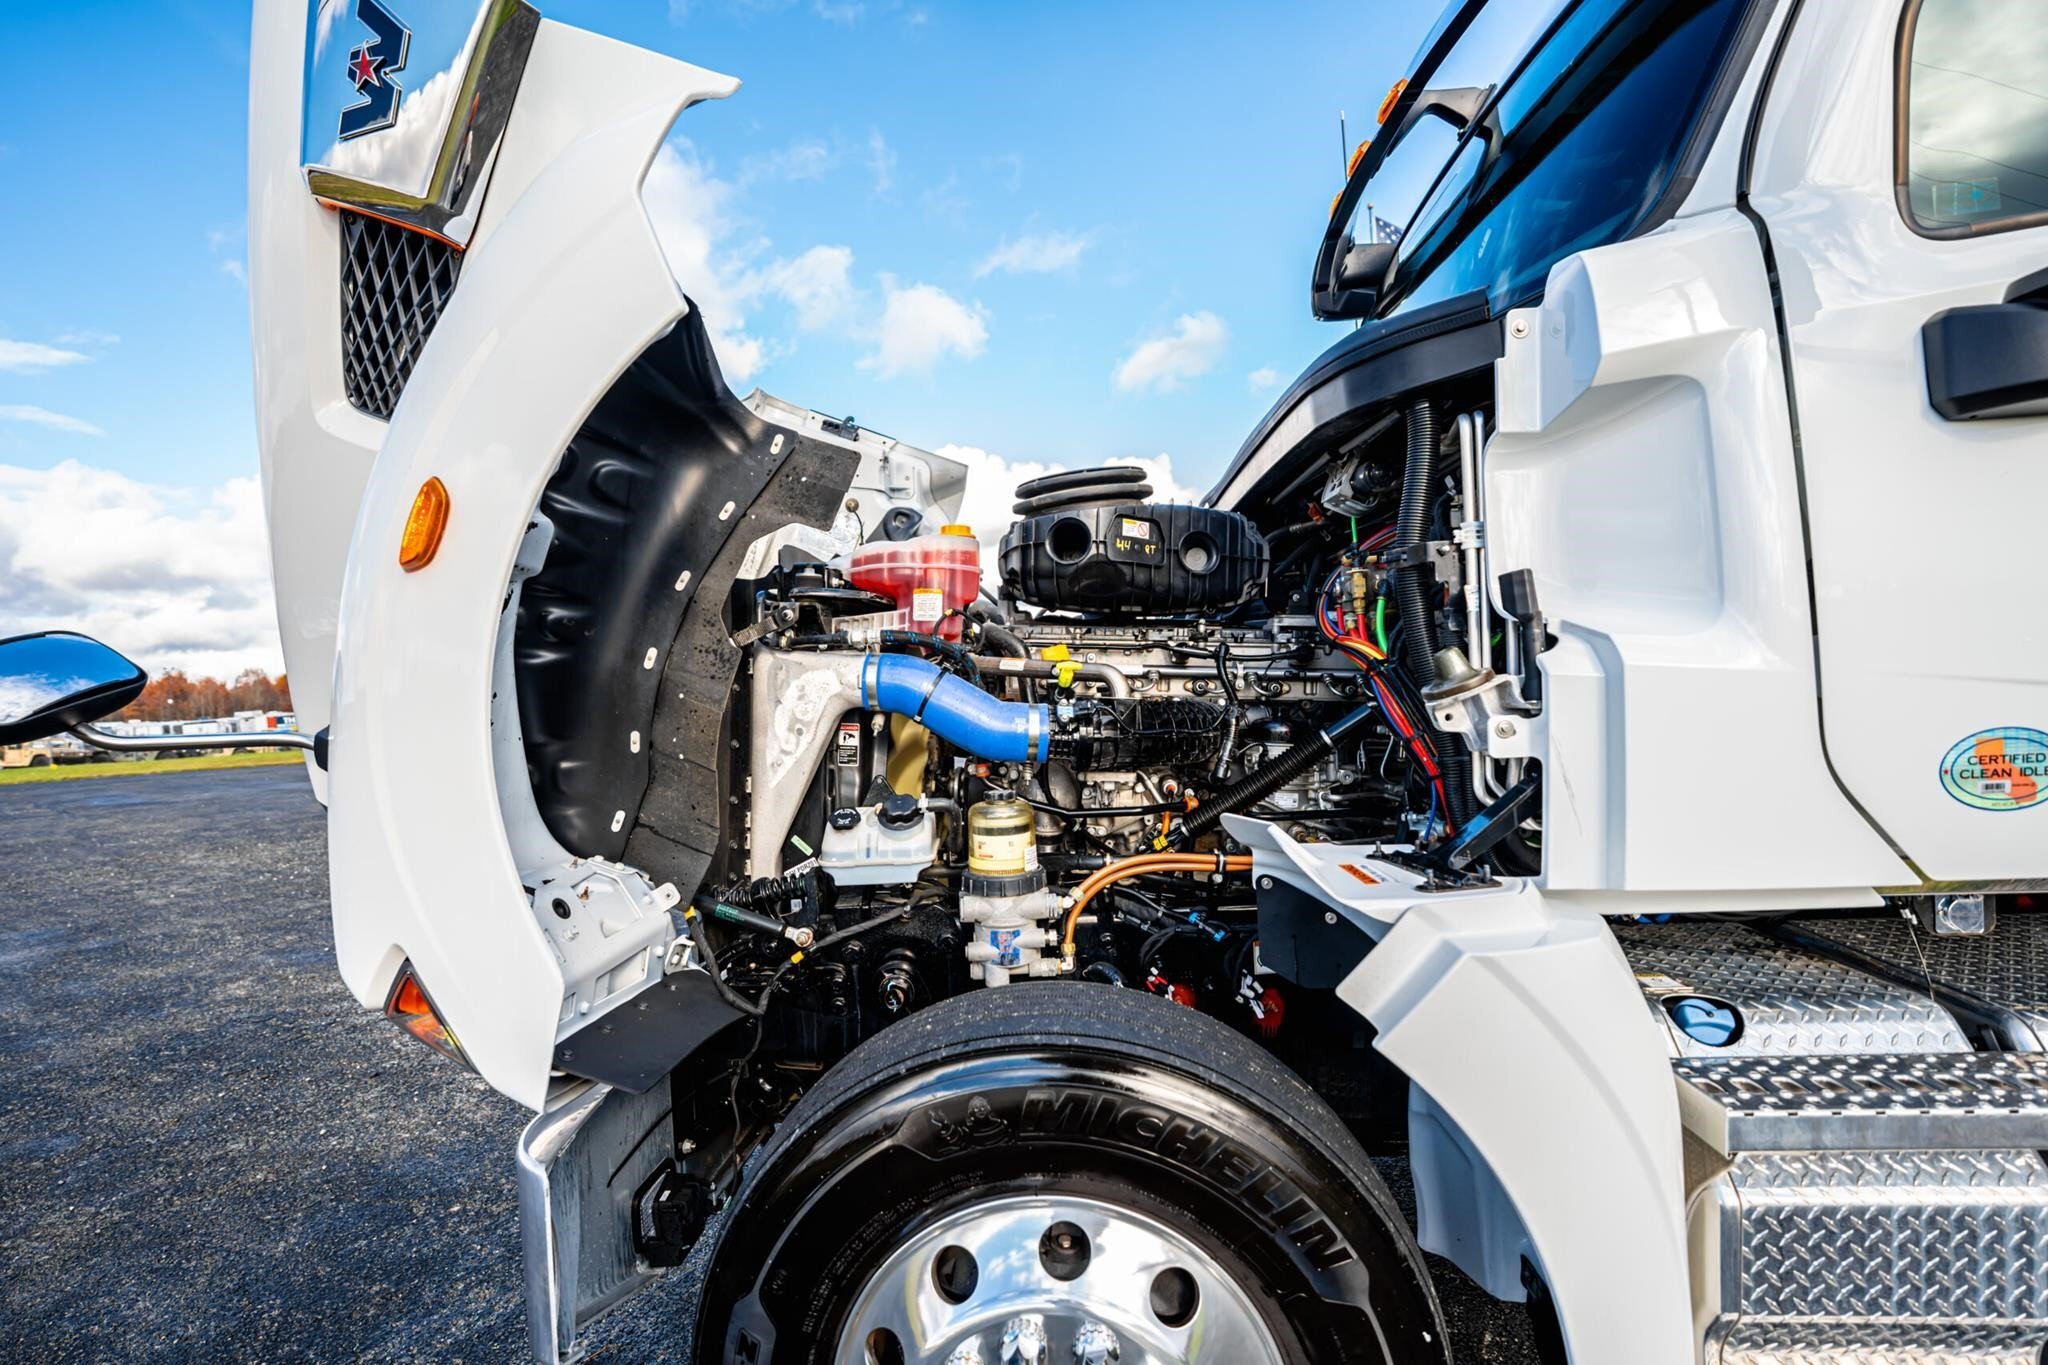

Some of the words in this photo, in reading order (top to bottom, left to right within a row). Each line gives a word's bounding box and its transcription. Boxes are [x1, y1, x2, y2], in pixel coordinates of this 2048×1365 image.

[1967, 752, 2047, 766] CERTIFIED
[1959, 767, 2012, 780] CLEAN
[1022, 1089, 1356, 1270] MICHELIN
